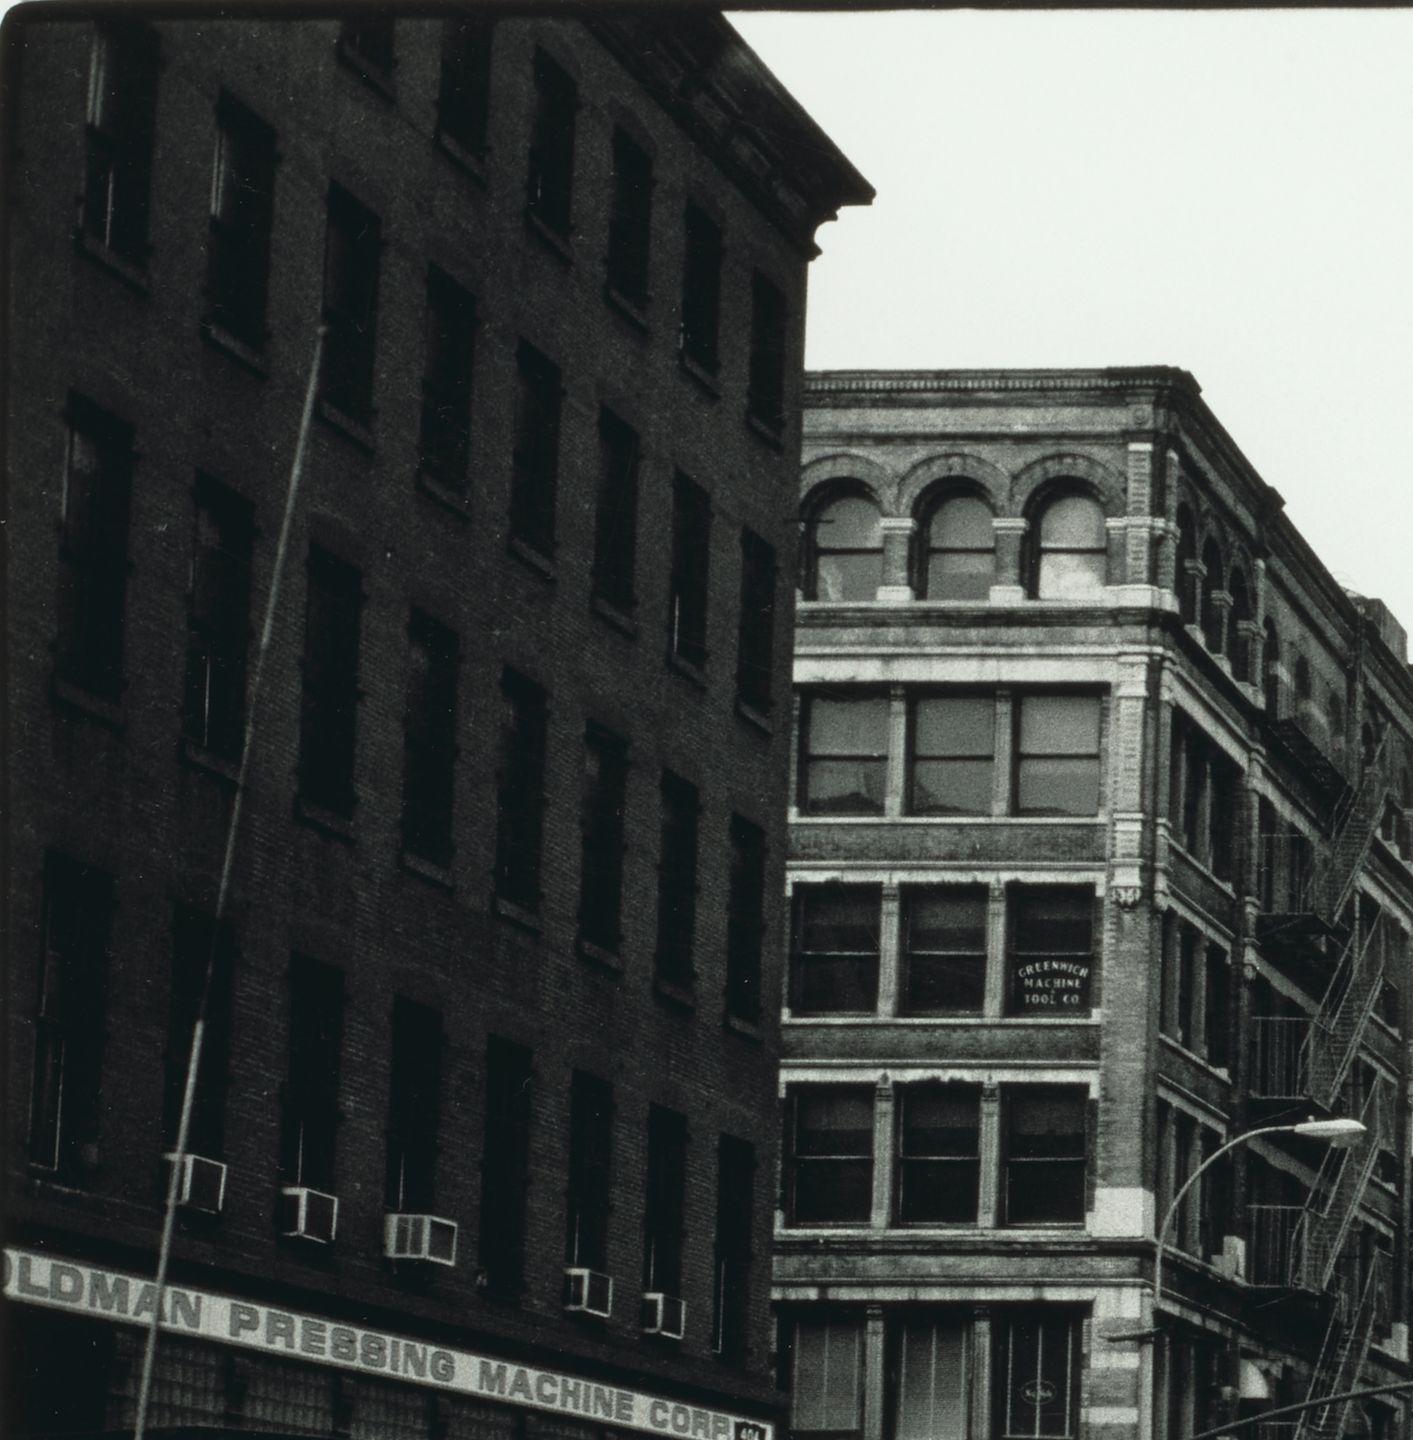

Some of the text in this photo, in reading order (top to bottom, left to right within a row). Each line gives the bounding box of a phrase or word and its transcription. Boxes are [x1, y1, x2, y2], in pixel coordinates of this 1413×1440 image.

[1017, 960, 1089, 978] GREENWICH
[1023, 978, 1082, 989] MACHINE
[1024, 993, 1057, 1005] TOOL
[228, 1302, 456, 1382] PRESSING
[478, 1360, 634, 1423] MACHINE
